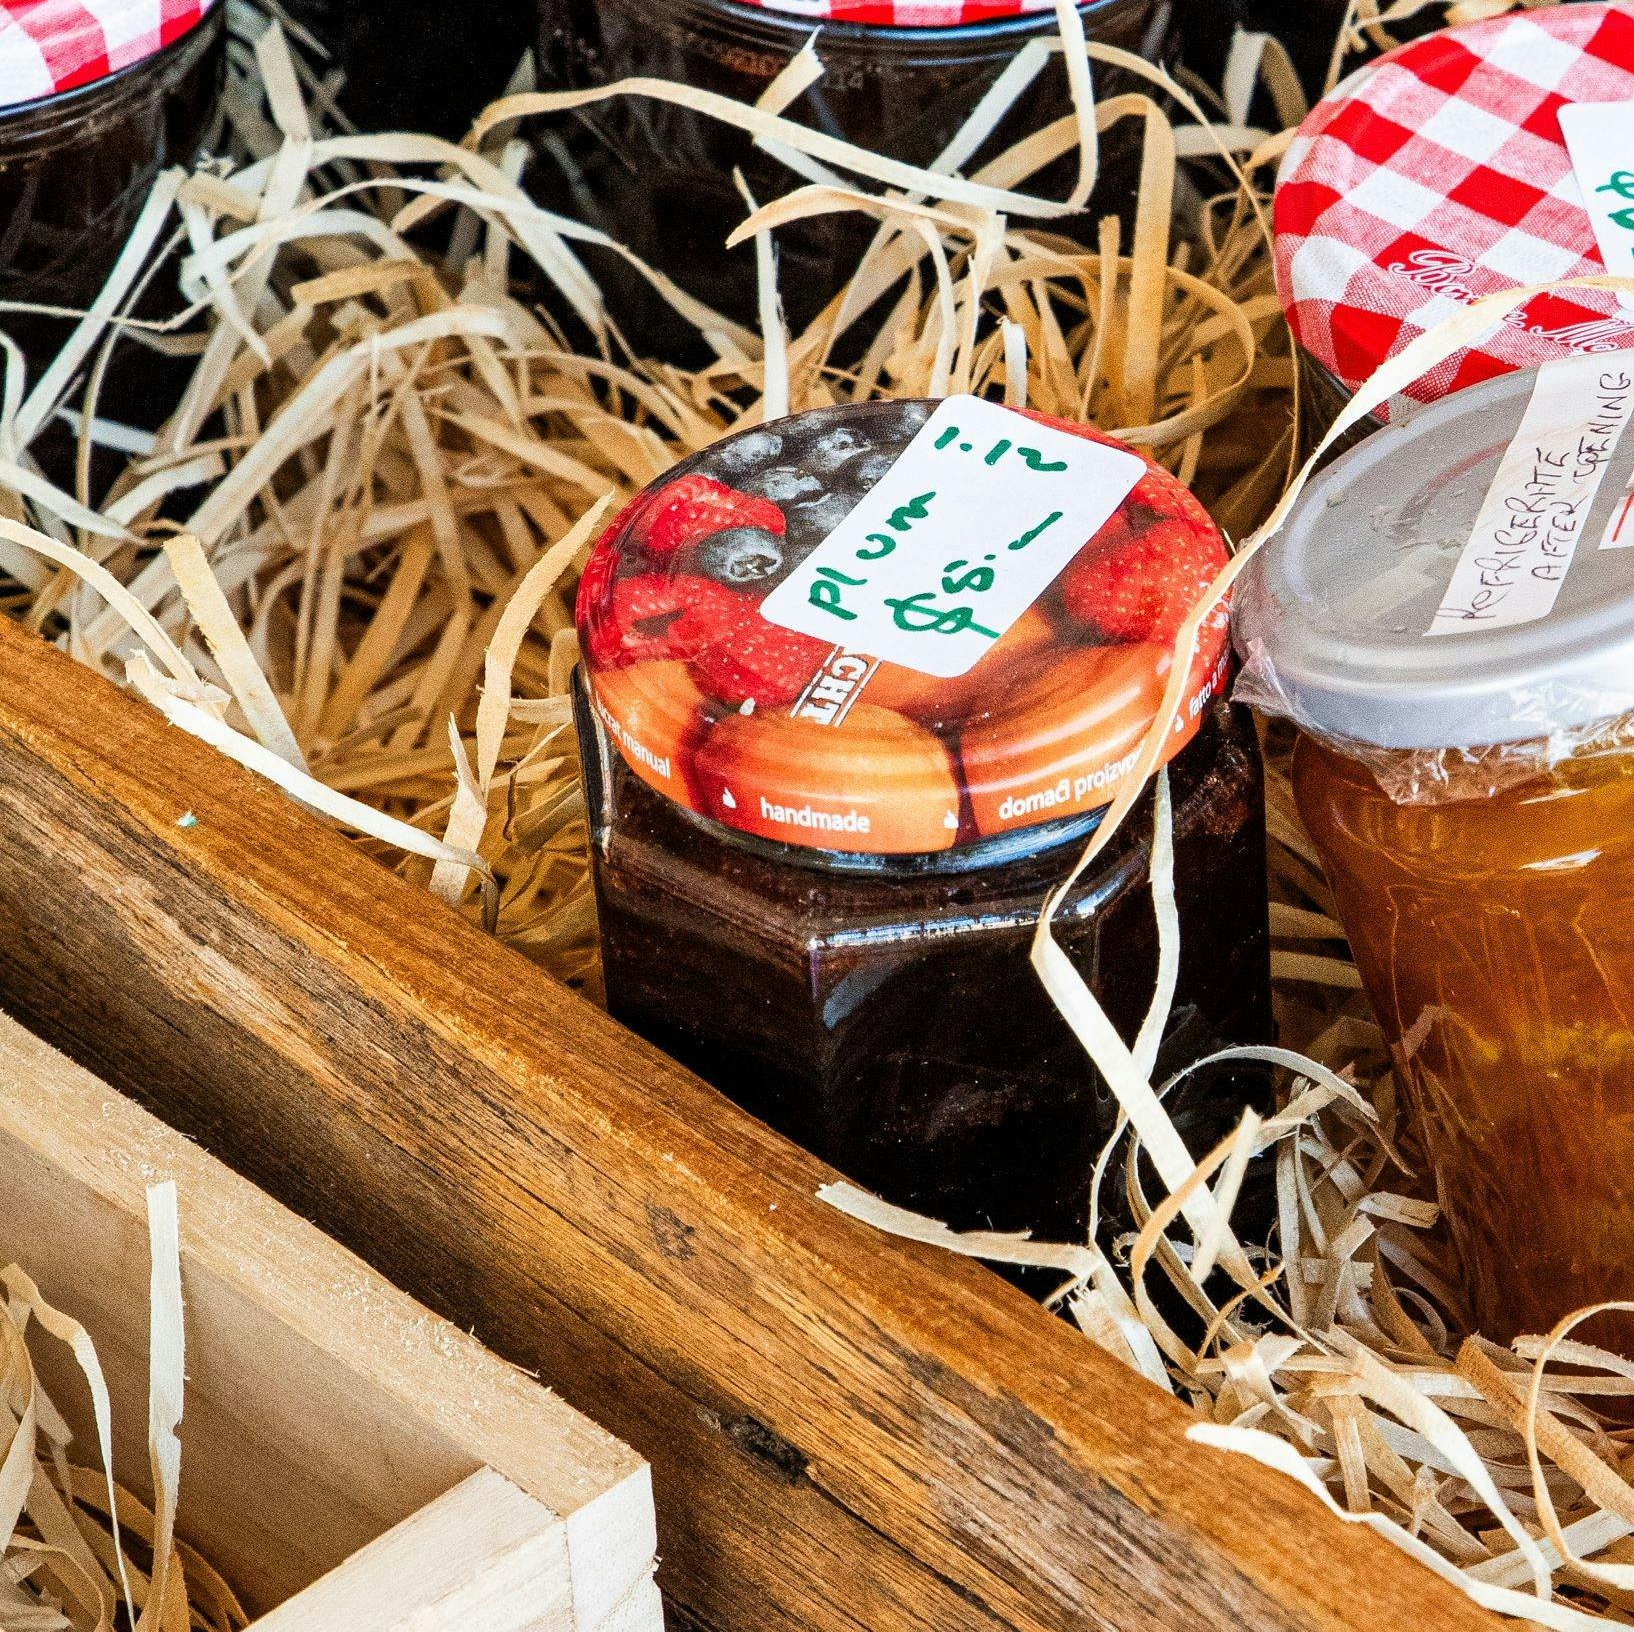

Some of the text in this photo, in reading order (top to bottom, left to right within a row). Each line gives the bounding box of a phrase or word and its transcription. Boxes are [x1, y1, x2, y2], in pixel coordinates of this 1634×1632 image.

[1531, 493, 1590, 581] AFTER
[622, 729, 671, 780] manual
[759, 796, 871, 835] handmade
